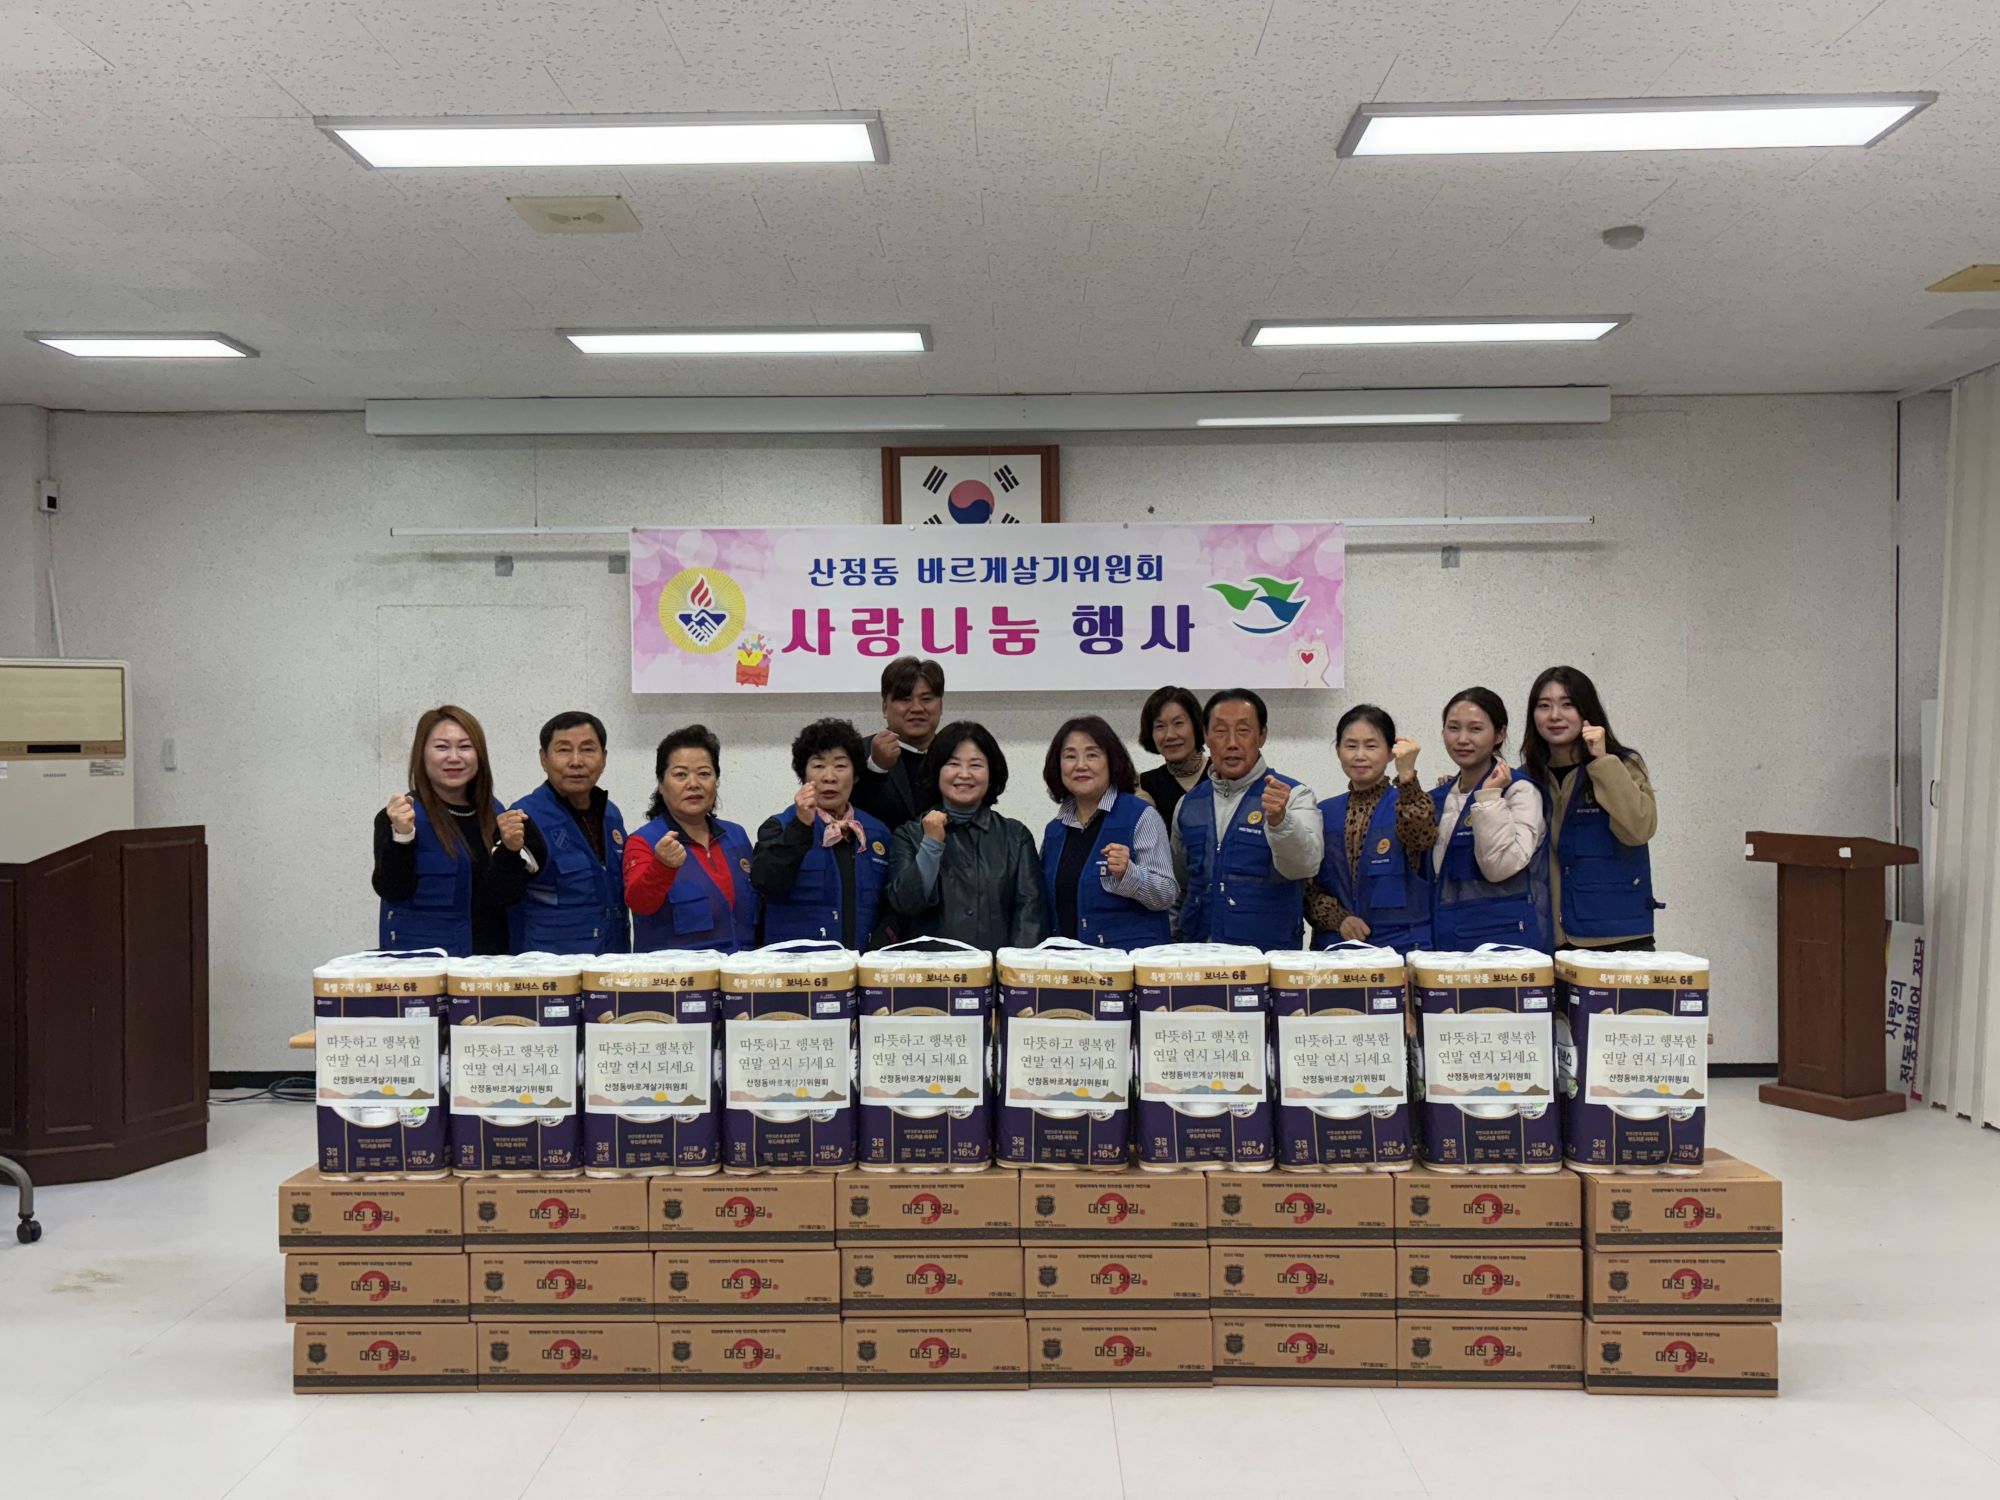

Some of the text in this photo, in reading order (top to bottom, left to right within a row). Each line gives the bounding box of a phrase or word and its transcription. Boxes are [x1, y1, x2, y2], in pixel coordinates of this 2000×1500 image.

[807, 554, 1164, 586] 산정동 바르게살기위원회
[781, 603, 1195, 656] 사랑나눔 행사
[651, 977, 677, 987] 보너스
[926, 973, 951, 983] 보너스
[1071, 975, 1097, 986] 보너스
[1204, 971, 1229, 981] 보너스
[1342, 974, 1368, 984] 보너스
[1492, 973, 1518, 983] 보너스
[1652, 975, 1677, 985] 보너스
[375, 983, 400, 992] 보너스
[514, 982, 539, 992] 보너스
[786, 978, 811, 988] 보너스
[1886, 980, 1907, 1040] 사랑의
[327, 1035, 421, 1049] 따뜻하고 행복한
[874, 1033, 967, 1047] 따뜻하고 행복한
[1155, 1030, 1250, 1043] 따뜻하고 행복한
[1295, 1032, 1391, 1048] 따뜻하고 행복한
[1440, 1031, 1536, 1045] 따뜻하고 행복한
[1605, 1033, 1698, 1048] 따뜻하고 행복한
[599, 1041, 694, 1055] 따뜻하고 행복한
[740, 1037, 834, 1052] 따뜻하고 행복한
[1023, 1036, 1116, 1052] 따뜻하고 행복한
[464, 1044, 559, 1058] 따뜻하고 행복한
[1153, 1049, 1251, 1062] 연말 연시 되세요
[1438, 1050, 1539, 1064] 연말 연시 되세요
[325, 1054, 422, 1068] 연말 연시 되세요
[739, 1056, 836, 1070] 연말 연시 되세요
[872, 1053, 969, 1066] 연말 연시 되세요
[1020, 1055, 1117, 1071] 연말 연시 되세요
[1294, 1051, 1393, 1067] 연말 연시 되세요
[1602, 1052, 1698, 1067] 연말 연시 되세요
[462, 1063, 561, 1076] 연말 연시 되세요
[597, 1060, 696, 1074] 연말 연시 되세요
[333, 1076, 415, 1084] 산정동바르게살기위원회
[880, 1075, 961, 1083] 산정동바르게살기위원회
[1161, 1071, 1244, 1079] 산정동바르게살기위원회
[1302, 1074, 1386, 1084] 산정동바르게살기위원회
[1447, 1072, 1531, 1081] 산정동바르게살기위원회
[1609, 1074, 1690, 1084] 산정동바르게살기위원회
[604, 1082, 688, 1091] 산정동바르게살기위원회
[1027, 1077, 1109, 1087] 산정동바르게살기위원회
[470, 1085, 553, 1093] 산정동바르게살기위원회
